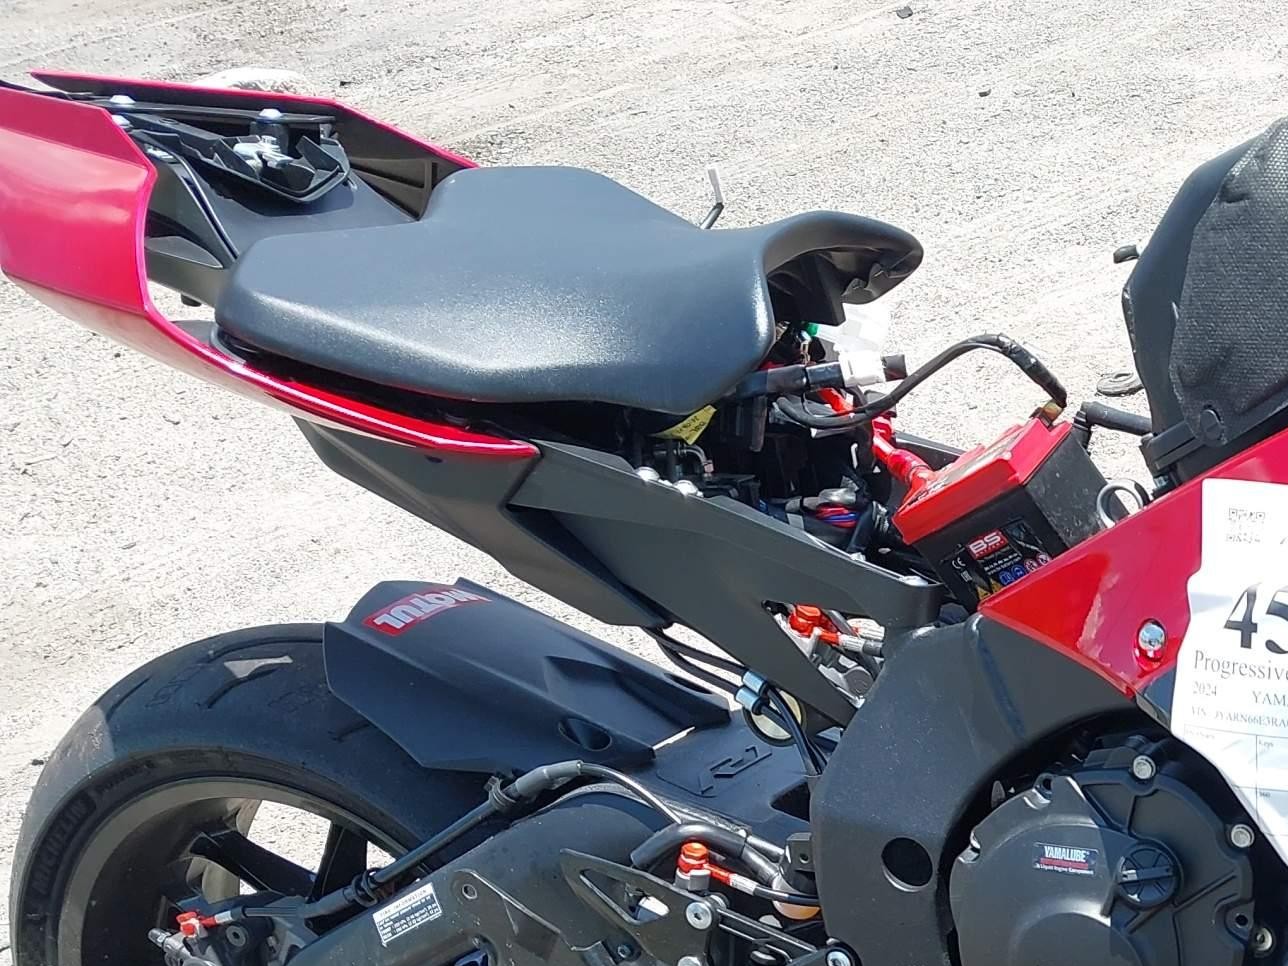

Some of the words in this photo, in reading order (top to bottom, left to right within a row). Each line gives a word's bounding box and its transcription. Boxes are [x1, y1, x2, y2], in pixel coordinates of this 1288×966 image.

[970, 530, 1002, 554] BS
[373, 588, 492, 630] MOTUL
[1192, 680, 1217, 697] 2024
